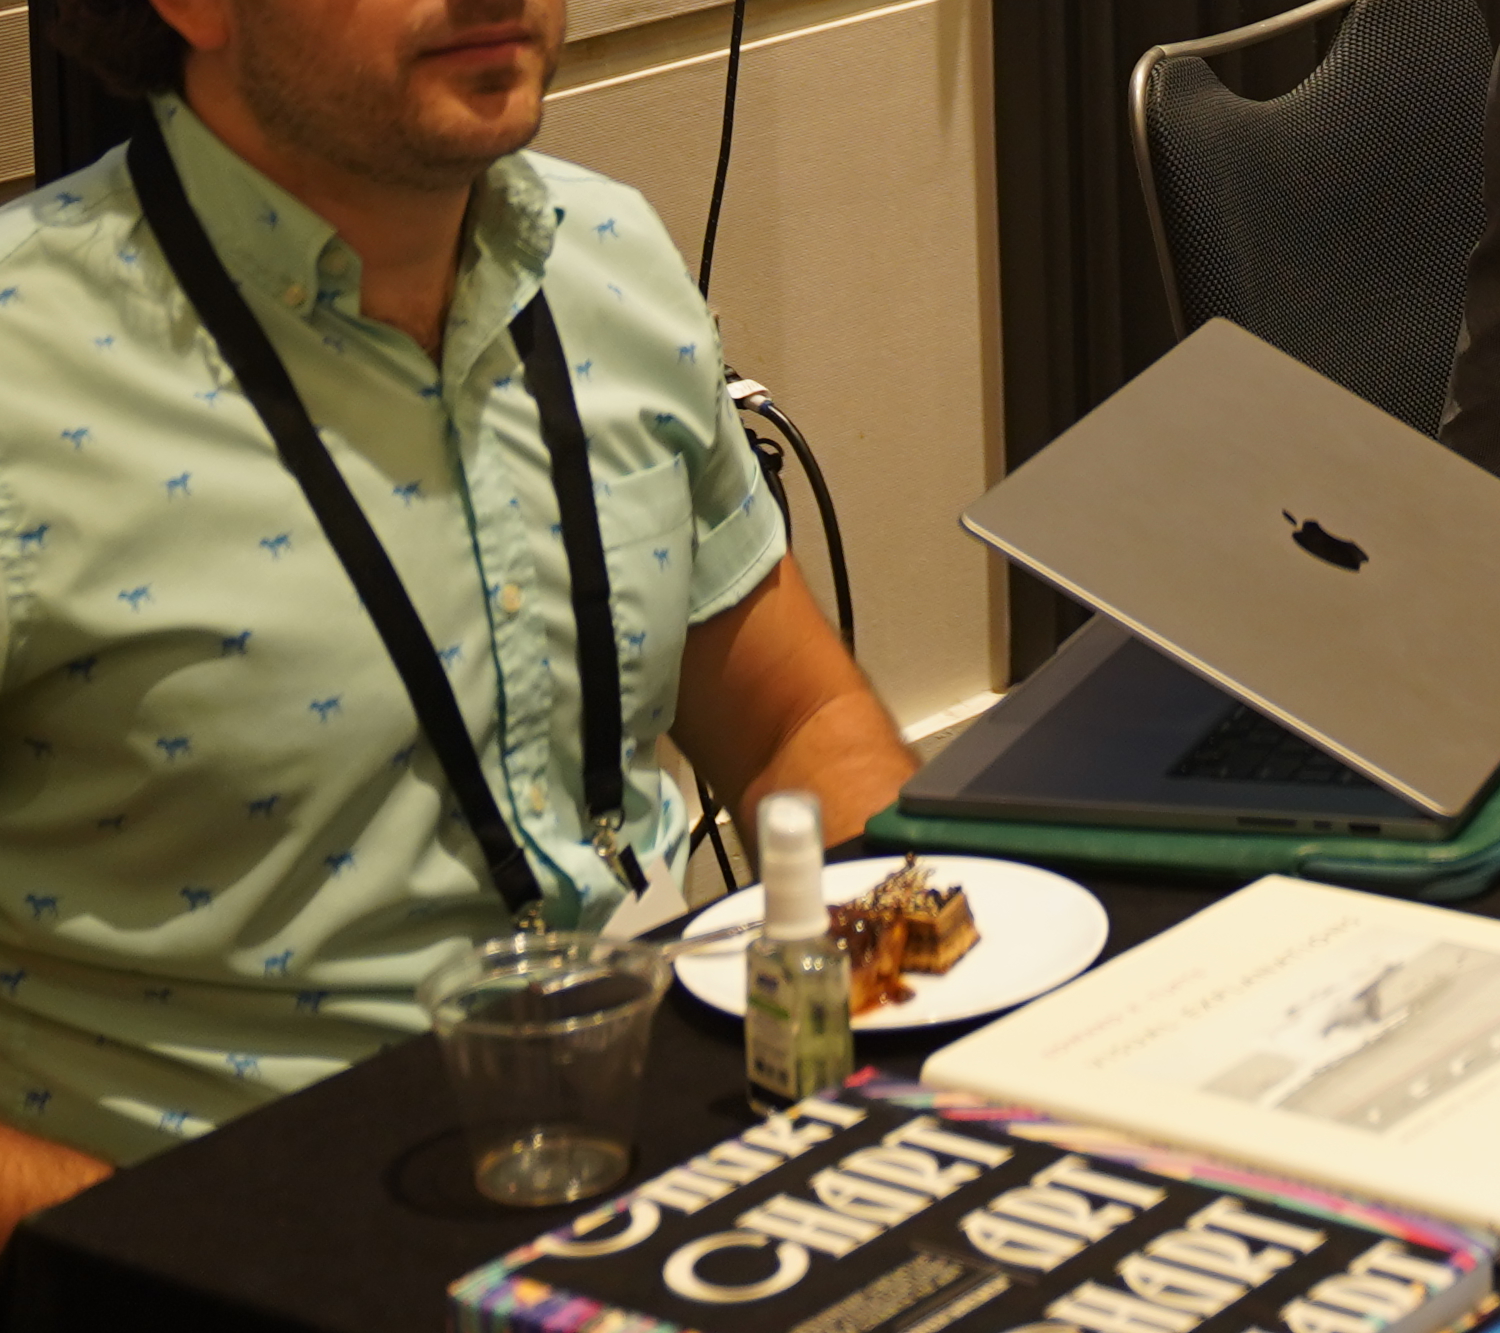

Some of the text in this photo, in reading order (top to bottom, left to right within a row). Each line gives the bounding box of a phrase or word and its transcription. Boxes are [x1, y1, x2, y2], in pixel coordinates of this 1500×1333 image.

[663, 1115, 1014, 1303] CHART
[960, 1153, 1169, 1272] ART
[1002, 1196, 1328, 1333] HART
